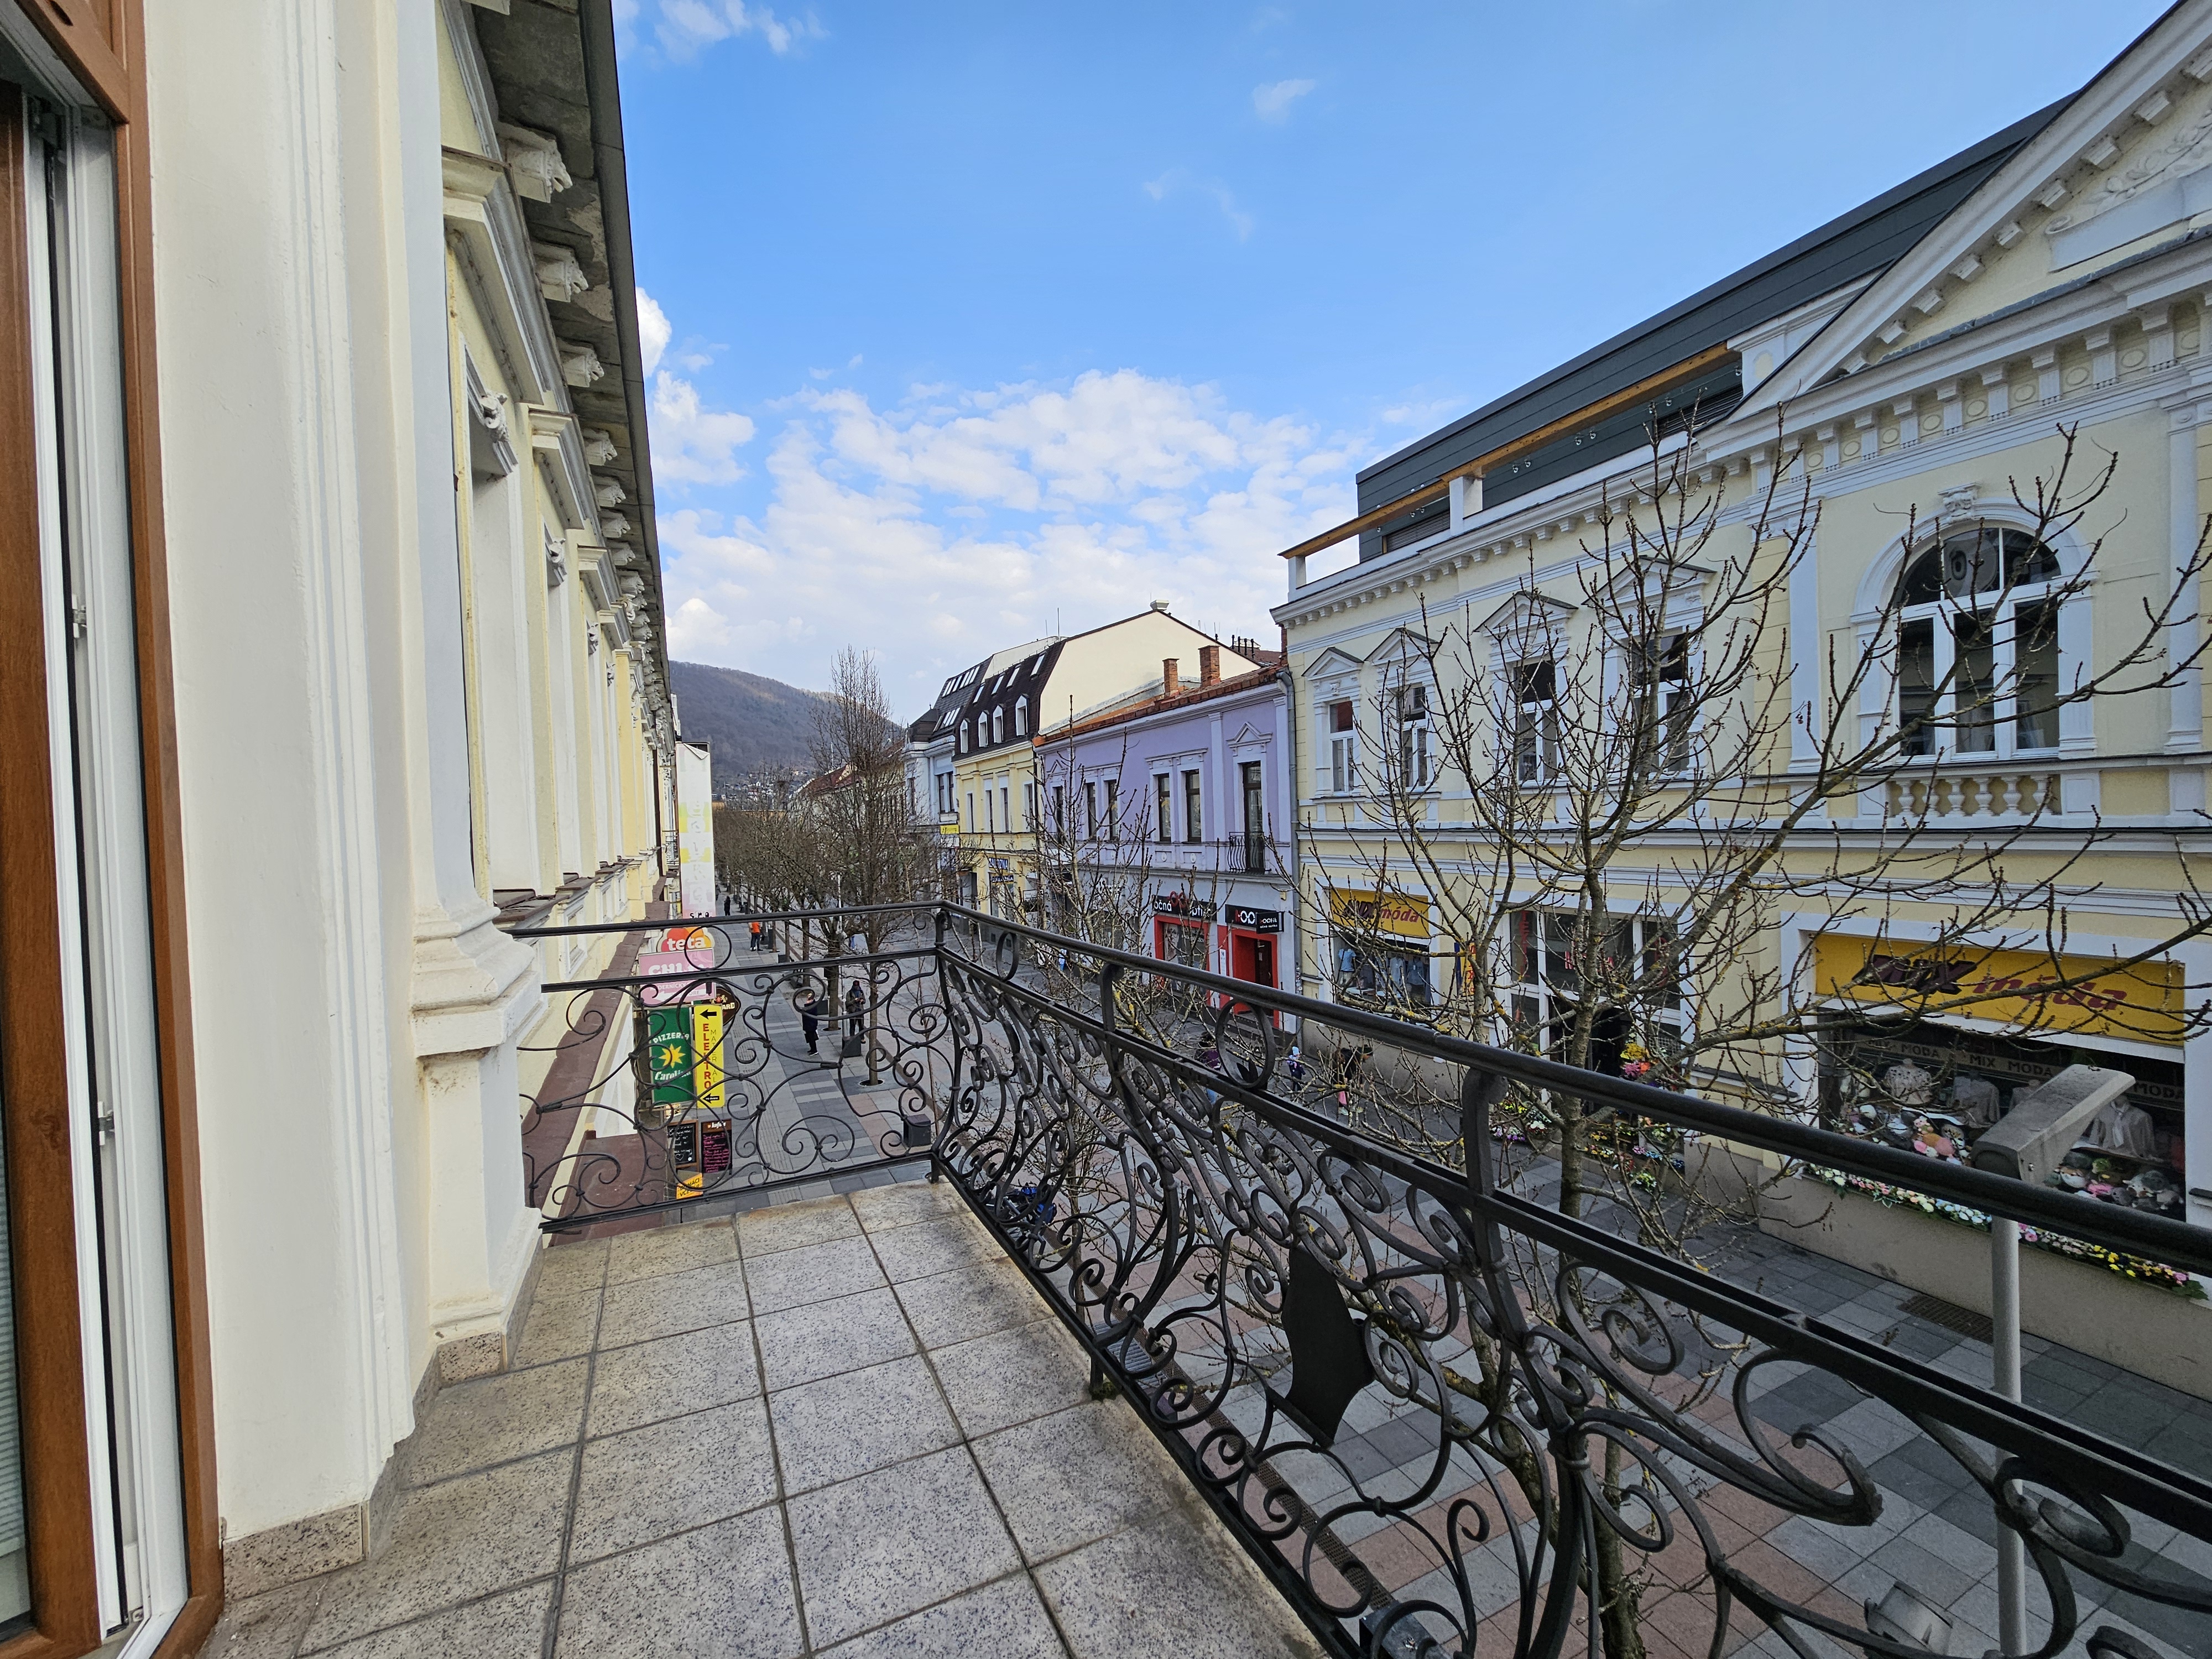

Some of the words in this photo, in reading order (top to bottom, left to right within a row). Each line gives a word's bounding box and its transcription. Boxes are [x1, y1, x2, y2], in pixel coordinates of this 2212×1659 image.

[1154, 899, 1172, 911] očná
[1380, 906, 1420, 922] móda
[667, 937, 706, 951] teta
[1969, 1054, 1996, 1067] MIX
[2008, 1061, 2053, 1077] MODA
